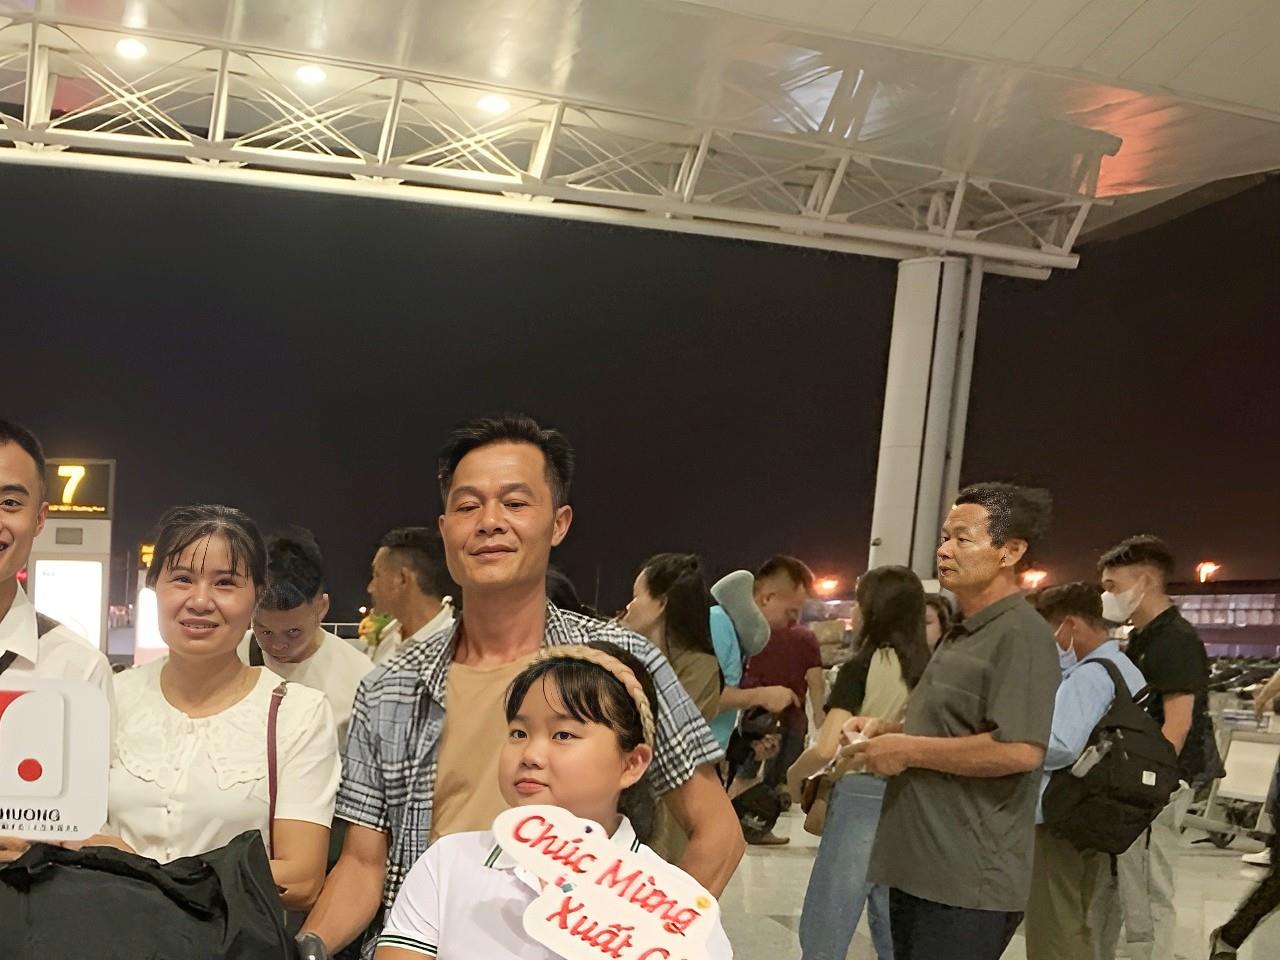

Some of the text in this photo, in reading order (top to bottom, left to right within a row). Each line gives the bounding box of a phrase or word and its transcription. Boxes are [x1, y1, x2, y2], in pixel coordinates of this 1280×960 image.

[57, 465, 86, 504] 7
[512, 814, 702, 937] Chúc Mừng
[545, 895, 634, 960] Xuất
